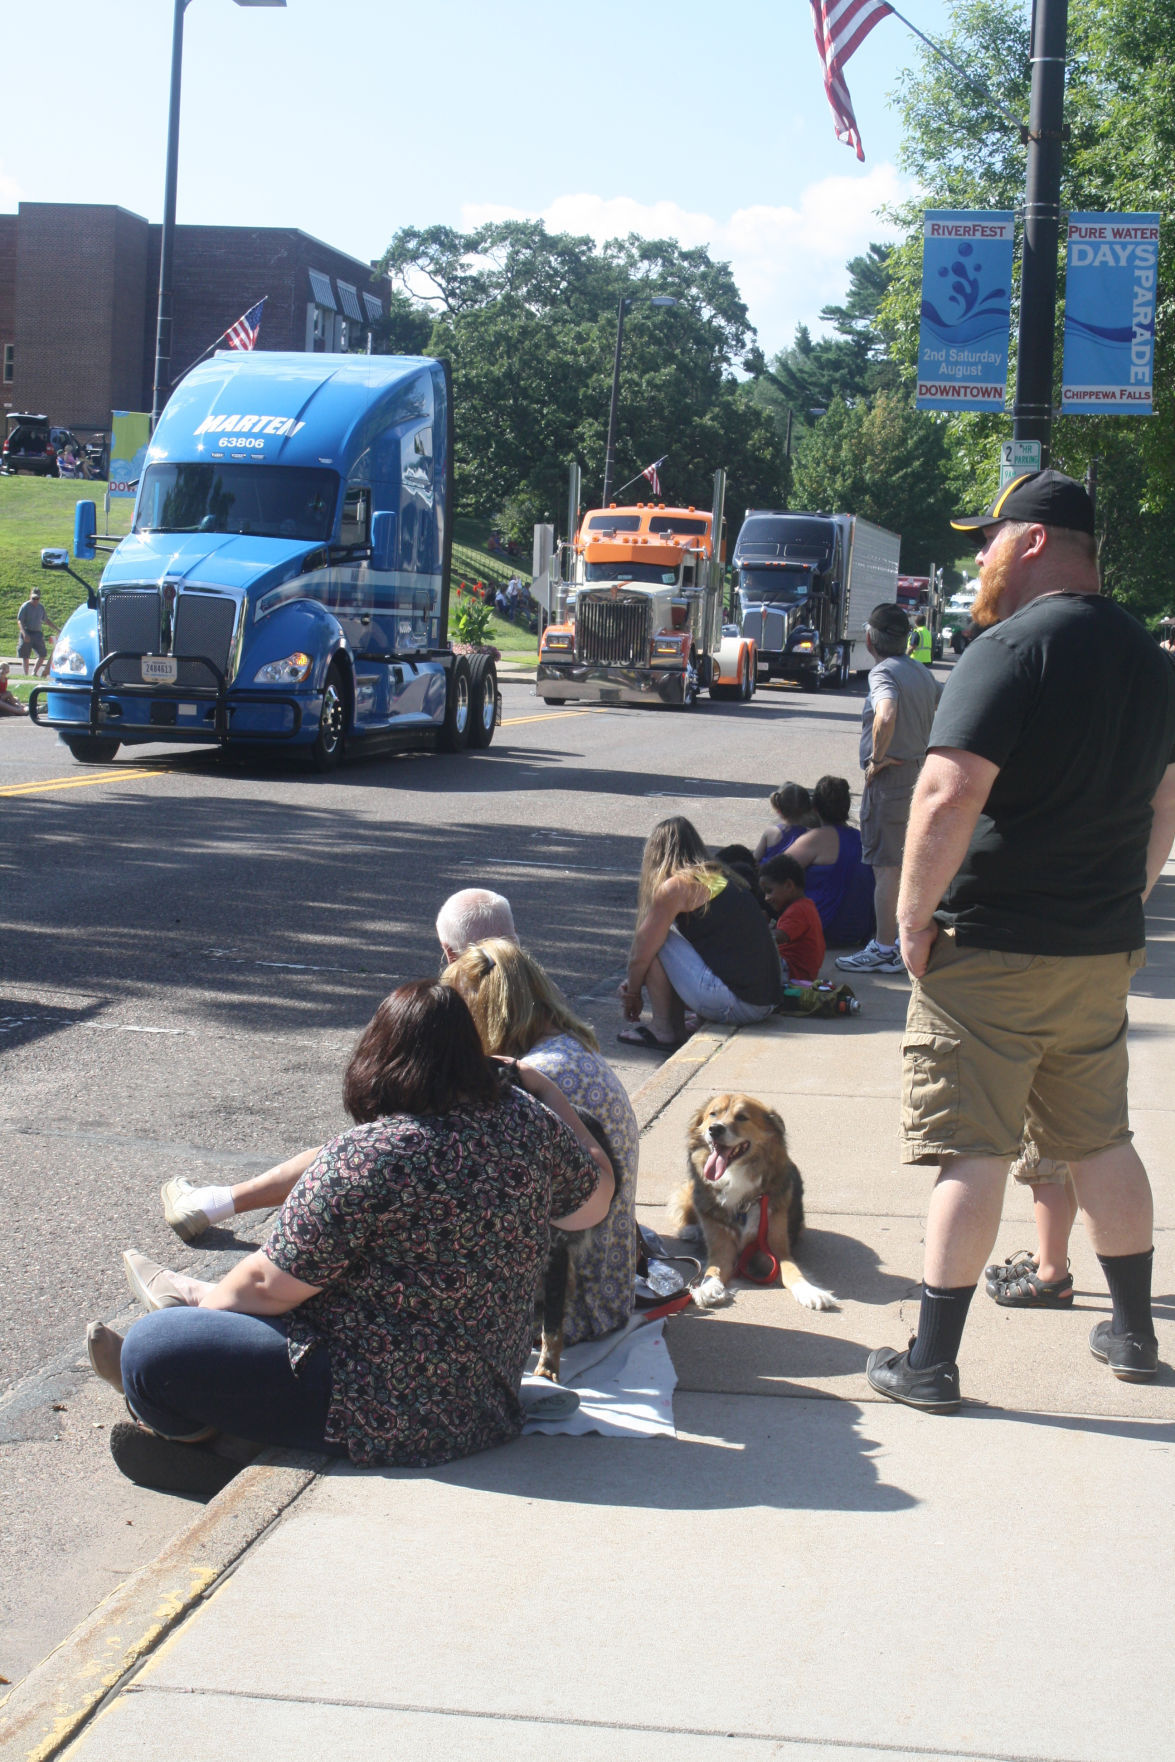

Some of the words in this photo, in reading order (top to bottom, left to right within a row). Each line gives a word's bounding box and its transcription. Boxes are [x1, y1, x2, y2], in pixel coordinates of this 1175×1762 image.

[1068, 225, 1107, 239] PURE
[1111, 227, 1159, 240] WATER
[1070, 244, 1156, 267] DAYS
[1130, 269, 1154, 384] PARADE
[923, 348, 946, 361] 2nd
[949, 349, 1002, 366] Saturday
[938, 362, 982, 378] August
[918, 384, 1003, 399] DOWNTOWN
[1064, 389, 1117, 400] CHIPPEWA
[1119, 389, 1151, 400] FALLS
[193, 414, 307, 438] MARTEN
[218, 437, 265, 449] 63806
[1005, 445, 1013, 462] 2
